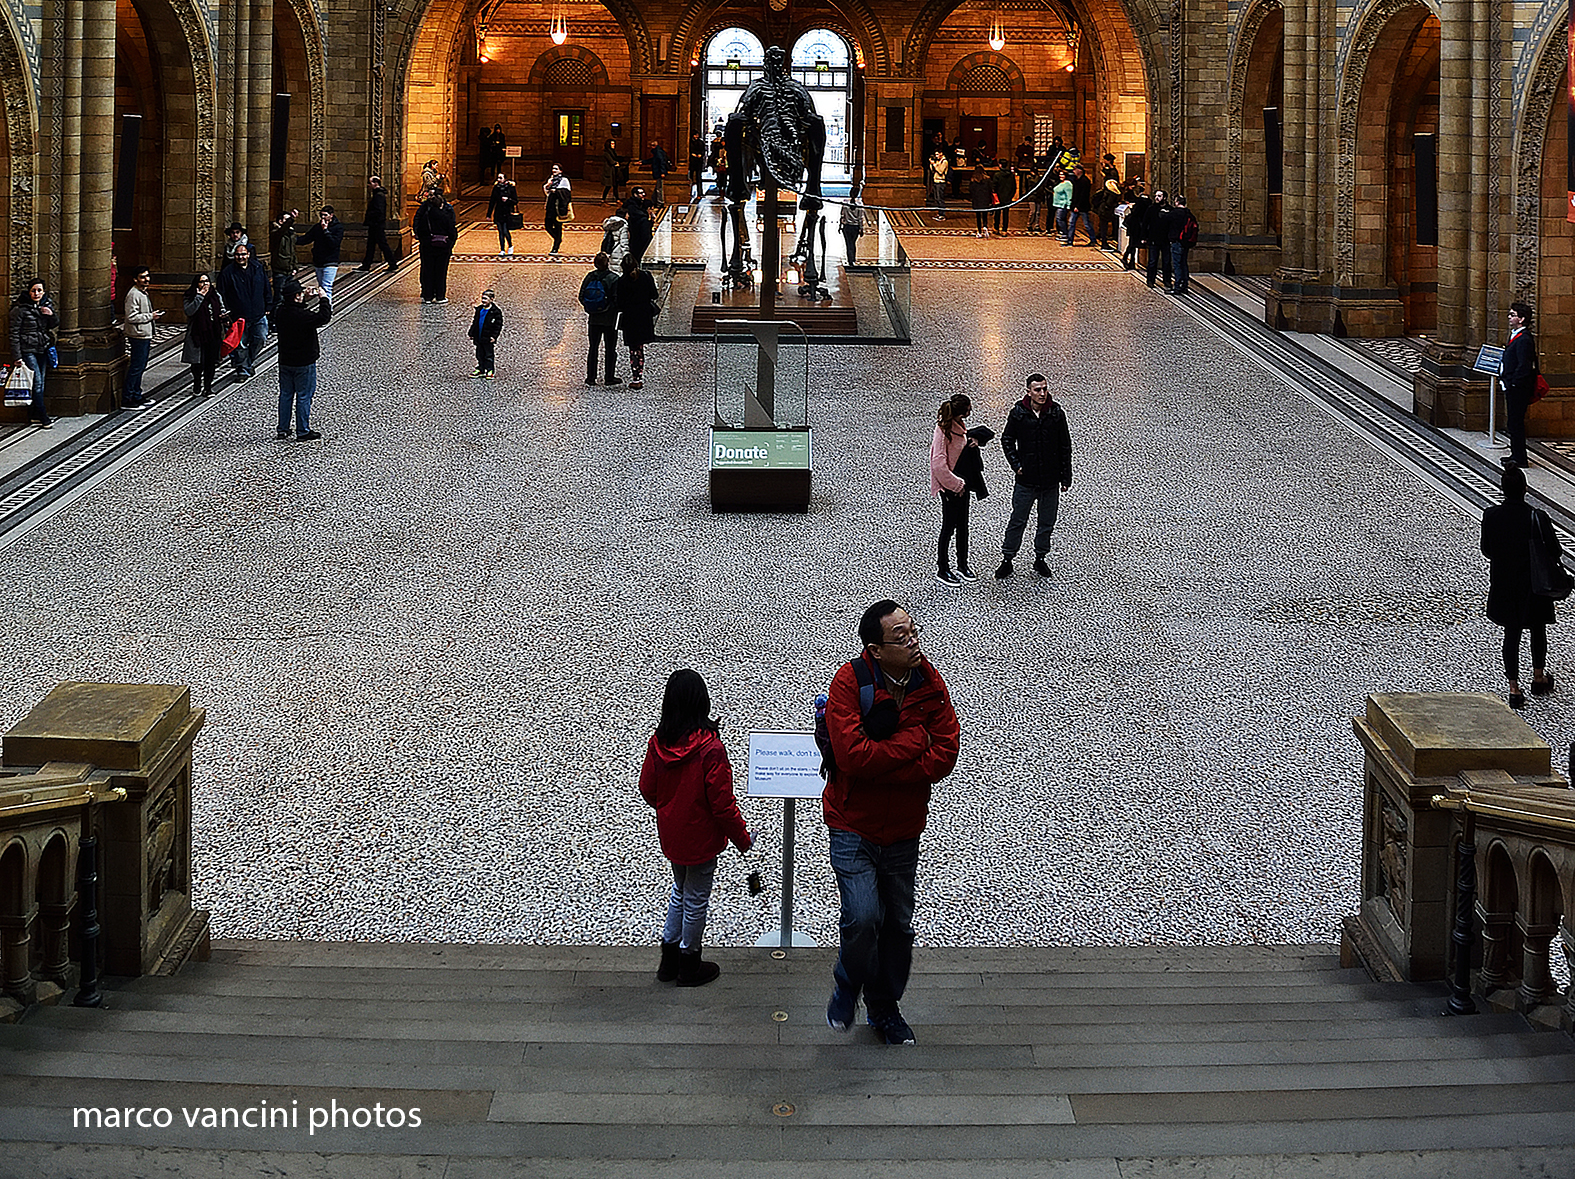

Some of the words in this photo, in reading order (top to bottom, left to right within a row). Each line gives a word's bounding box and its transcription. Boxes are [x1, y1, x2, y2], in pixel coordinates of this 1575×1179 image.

[715, 444, 768, 460] Donate
[779, 749, 795, 757] walk,
[796, 749, 813, 757] don't
